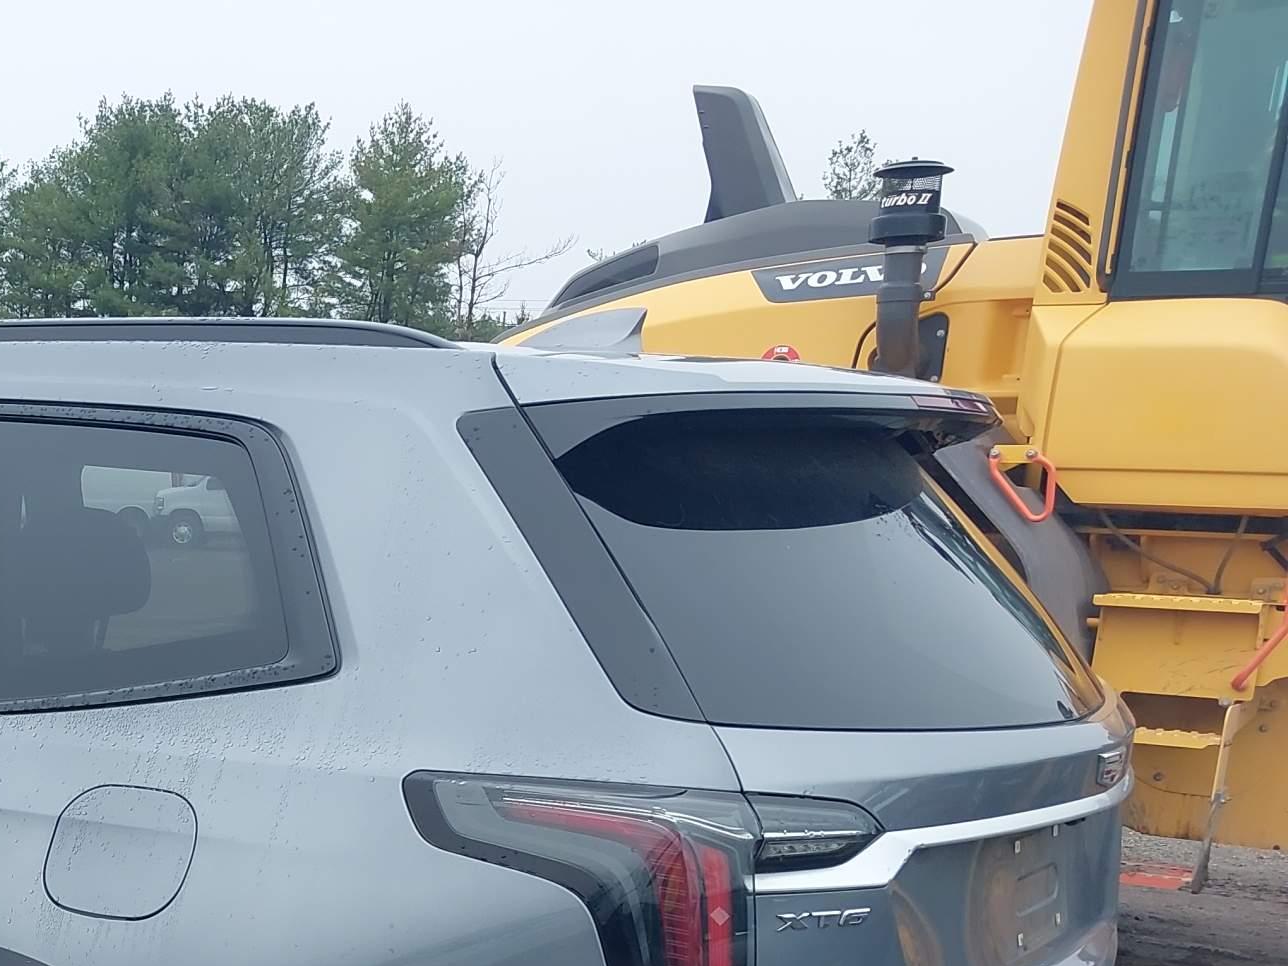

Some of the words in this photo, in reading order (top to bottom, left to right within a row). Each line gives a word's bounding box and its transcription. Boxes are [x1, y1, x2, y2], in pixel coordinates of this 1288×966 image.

[881, 193, 916, 208] turbo
[775, 262, 927, 291] VOLV
[776, 907, 870, 932] XT6
